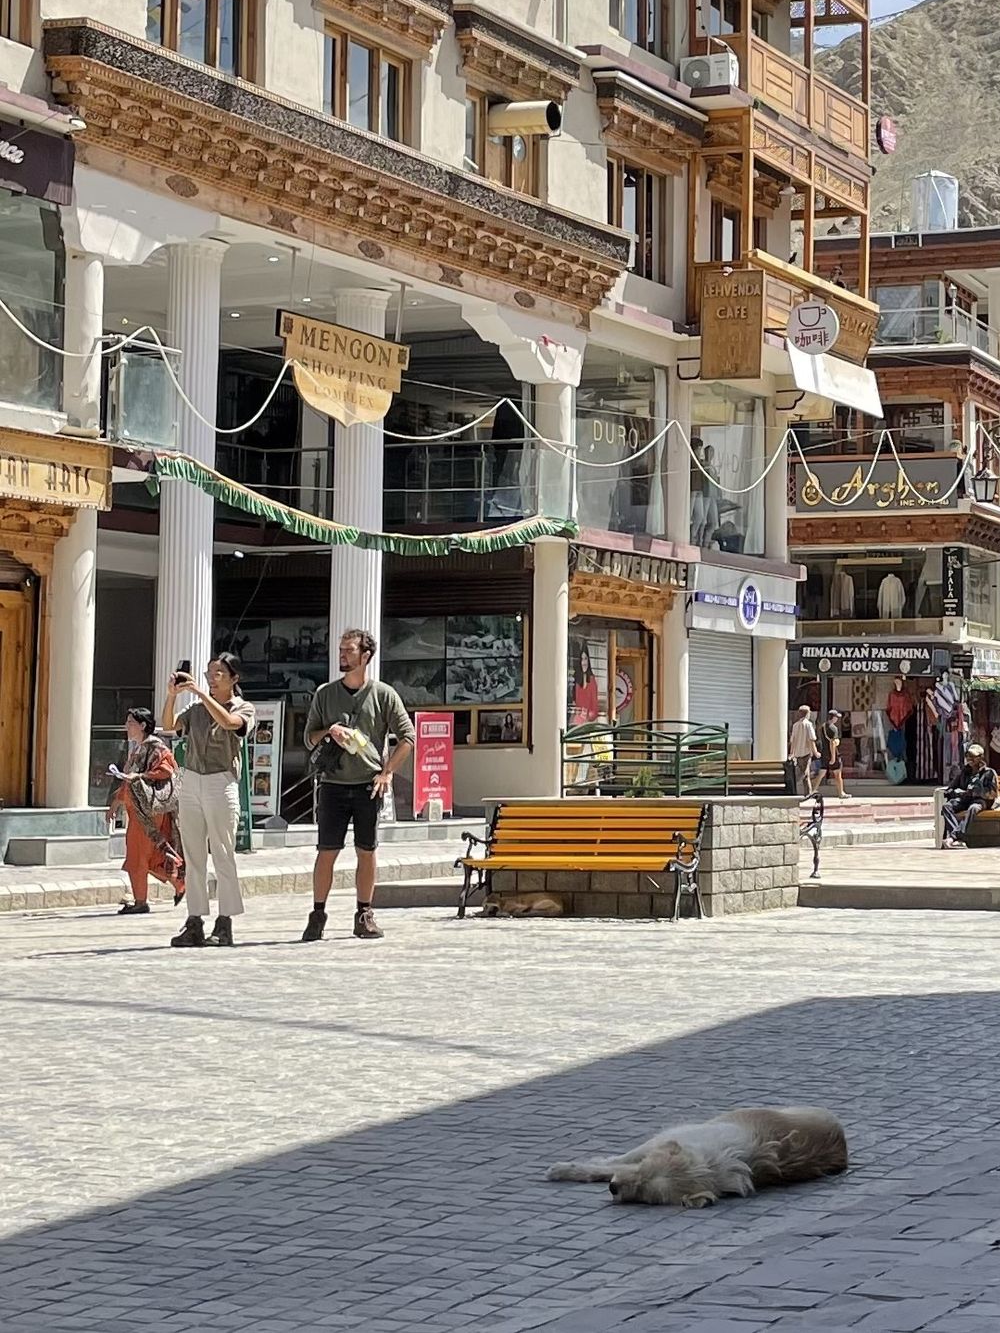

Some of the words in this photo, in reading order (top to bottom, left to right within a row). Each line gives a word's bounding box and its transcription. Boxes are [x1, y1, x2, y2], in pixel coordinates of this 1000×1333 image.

[716, 306, 748, 319] CAFE
[299, 324, 392, 368] MENGON
[301, 356, 387, 391] SHOPPING
[44, 462, 91, 496] ARTS
[802, 646, 869, 659] HIMALAYAN
[871, 647, 930, 660] PASHMINA
[841, 660, 889, 673] HOUSE
